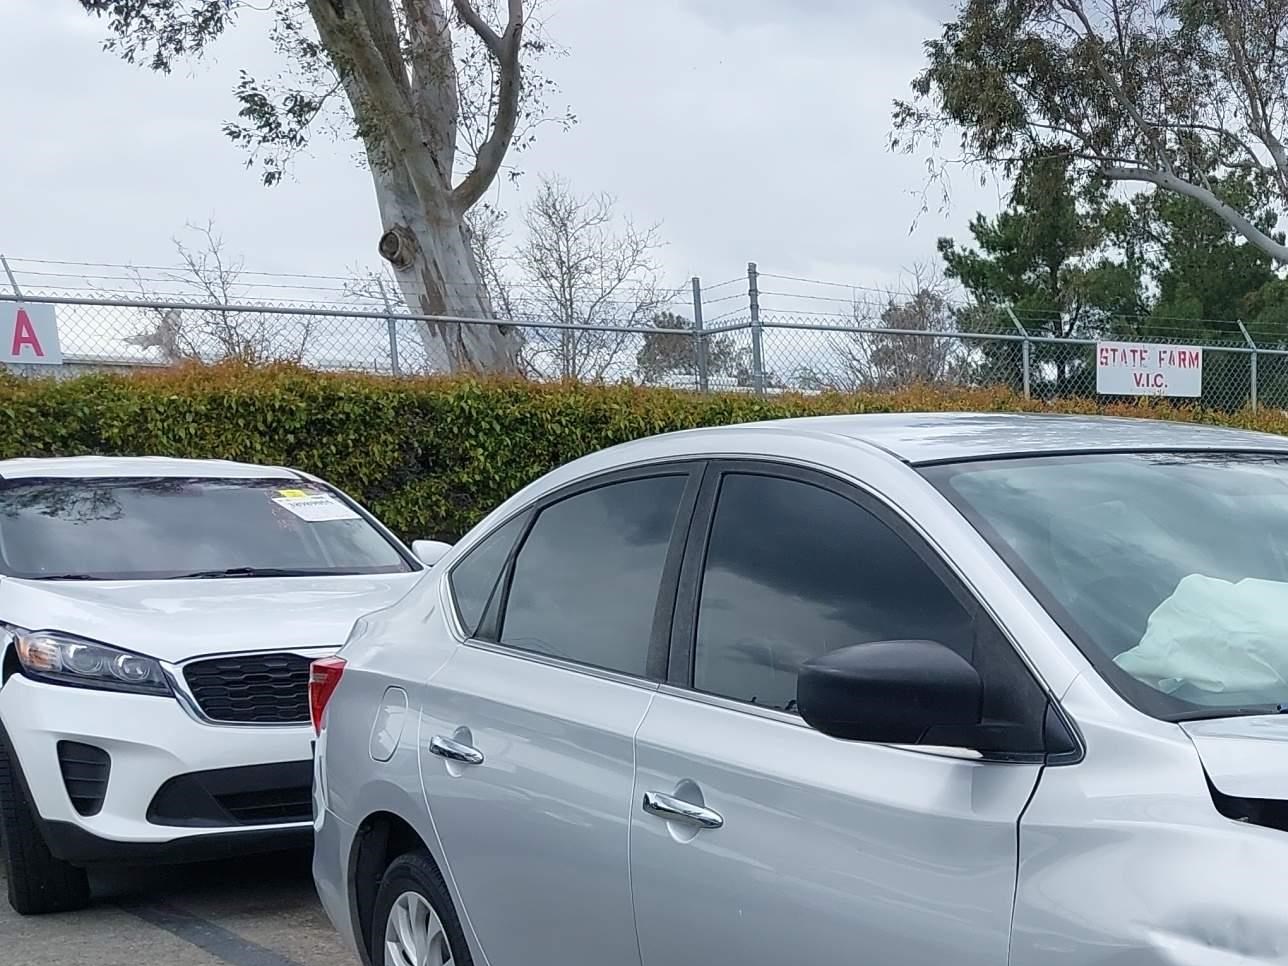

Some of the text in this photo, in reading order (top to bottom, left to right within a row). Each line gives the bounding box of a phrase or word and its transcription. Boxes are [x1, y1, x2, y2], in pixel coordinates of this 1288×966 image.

[11, 309, 45, 357] A
[1099, 347, 1199, 368] STATE FARM
[1133, 372, 1168, 388] V.I.C.
